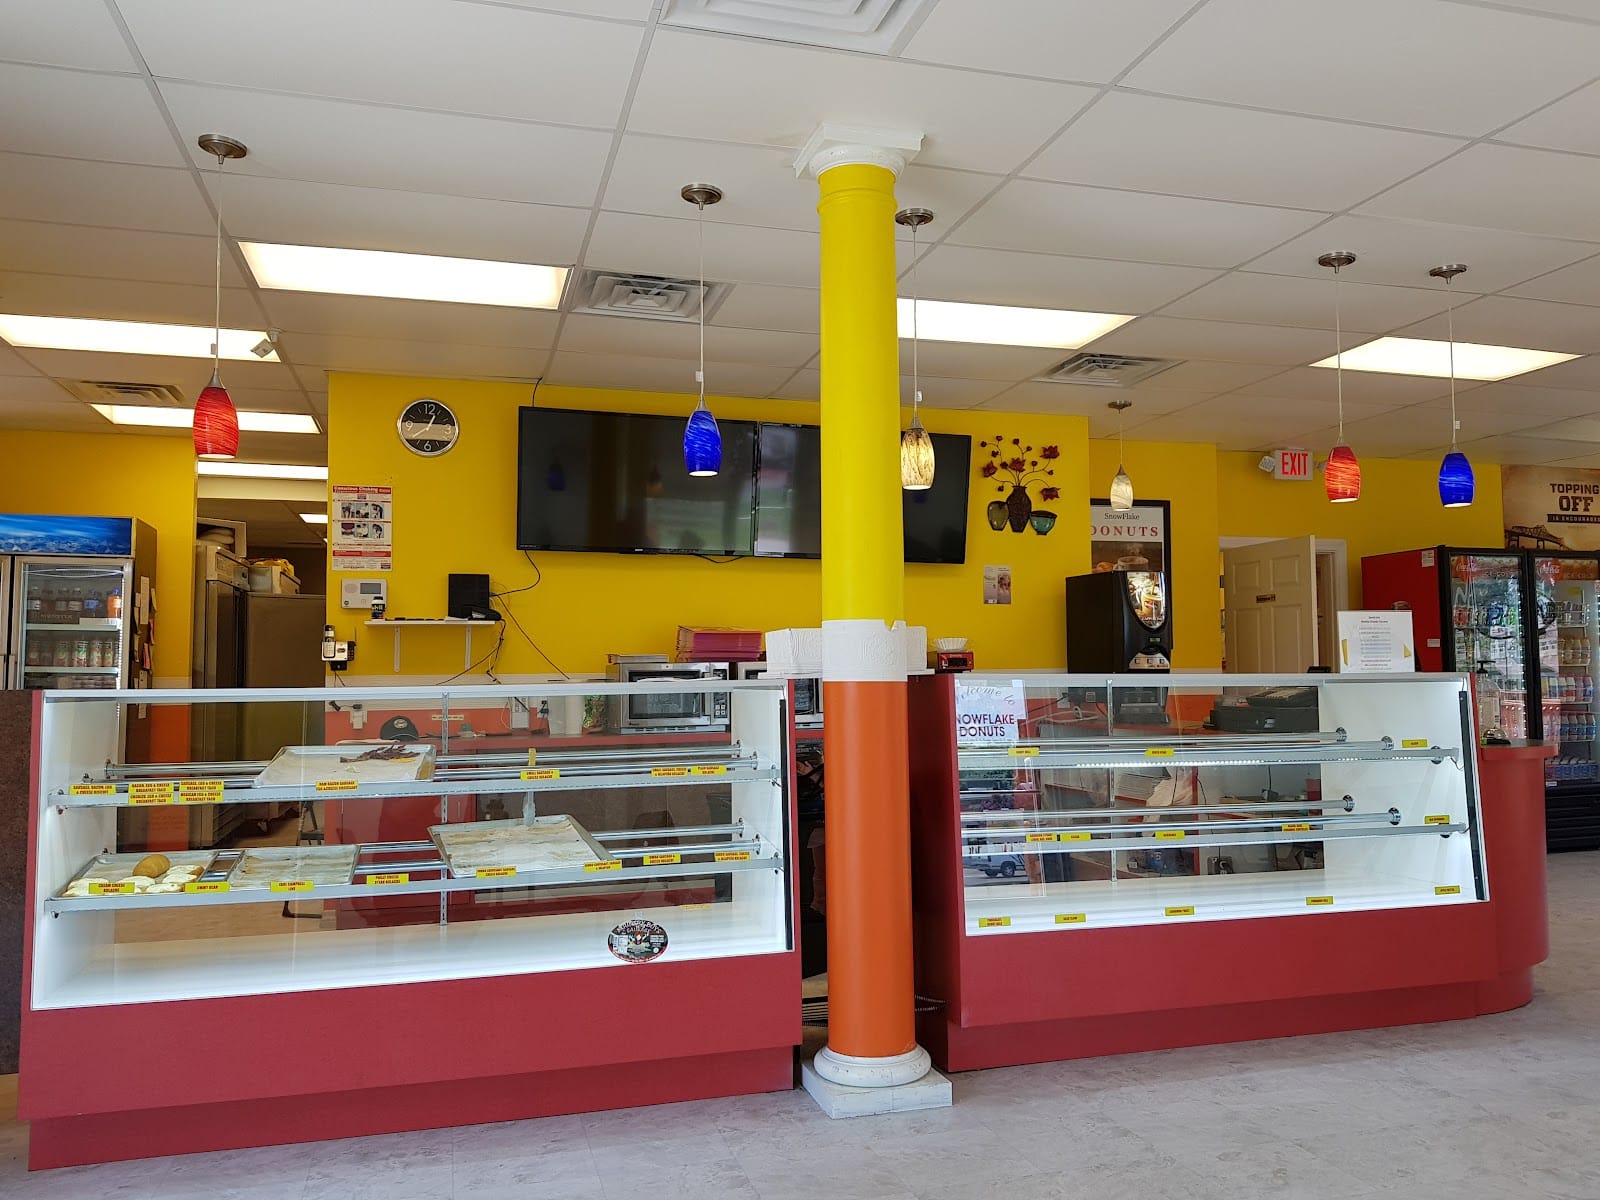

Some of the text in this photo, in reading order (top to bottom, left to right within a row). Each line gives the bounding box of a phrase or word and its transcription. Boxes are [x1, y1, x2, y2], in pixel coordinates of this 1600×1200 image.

[424, 403, 436, 415] 12
[405, 420, 414, 431] 9
[423, 440, 432, 451] 6
[1281, 451, 1309, 476] EXIT
[1549, 483, 1600, 495] TOPPING
[1558, 495, 1594, 512] OFF
[1104, 512, 1140, 520] SnowFlake
[959, 726, 1006, 738] DONUTS
